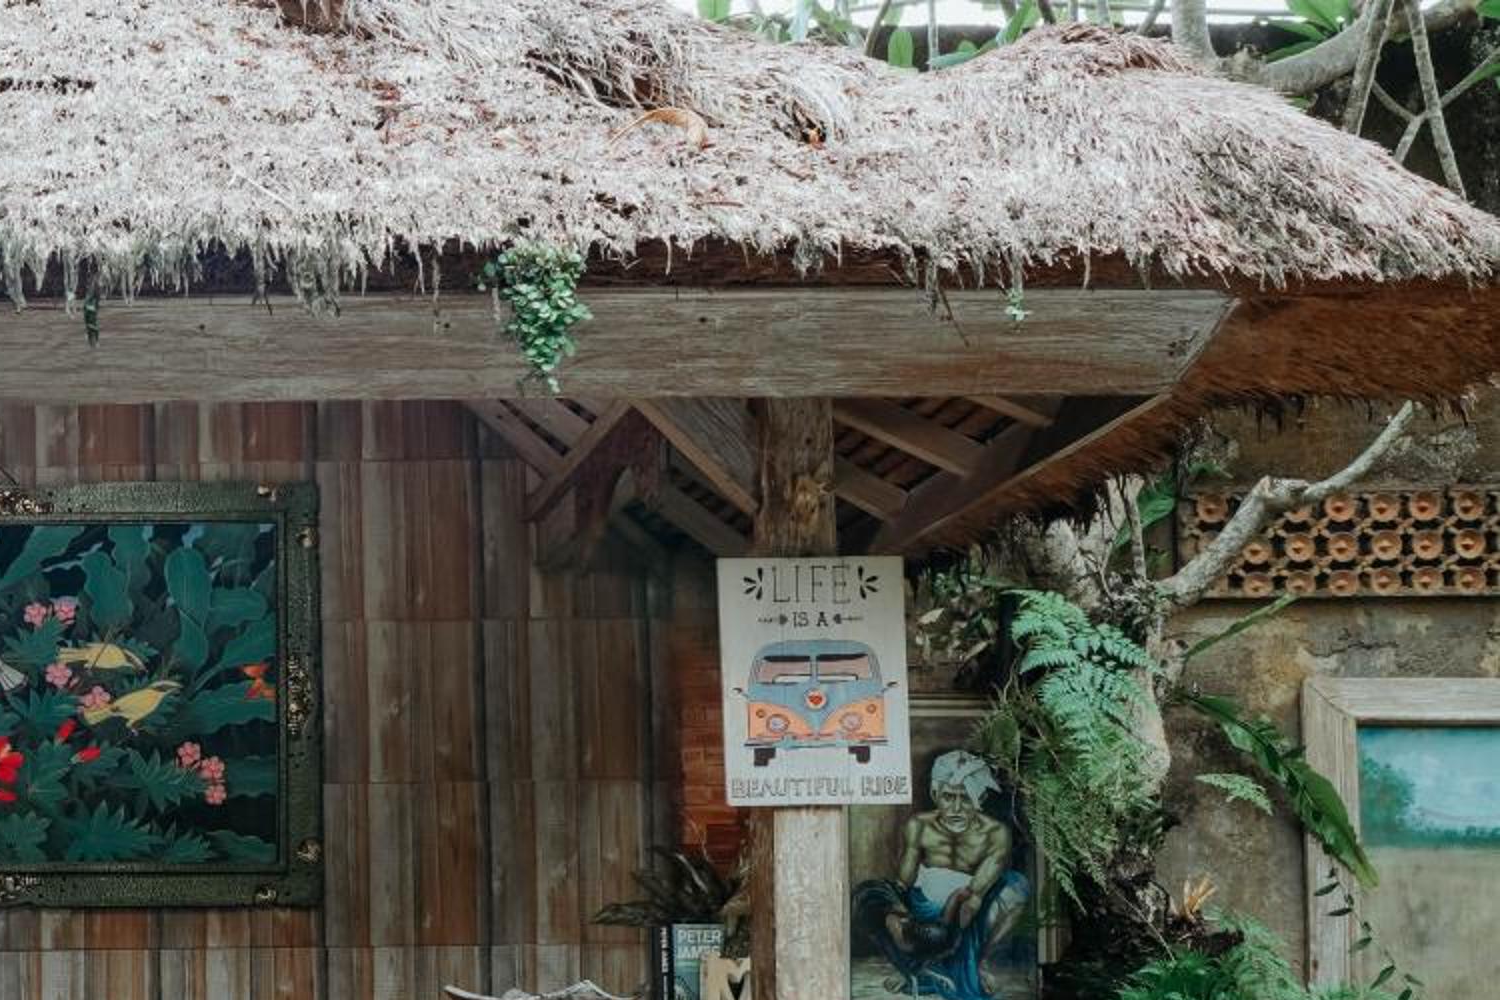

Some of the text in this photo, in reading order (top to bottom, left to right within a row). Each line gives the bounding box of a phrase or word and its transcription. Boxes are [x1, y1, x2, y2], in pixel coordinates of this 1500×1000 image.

[772, 565, 851, 604] LIFE
[793, 611, 829, 628] IS A
[731, 776, 909, 799] BEAUTIFUL RIDE
[677, 929, 722, 944] PETER
